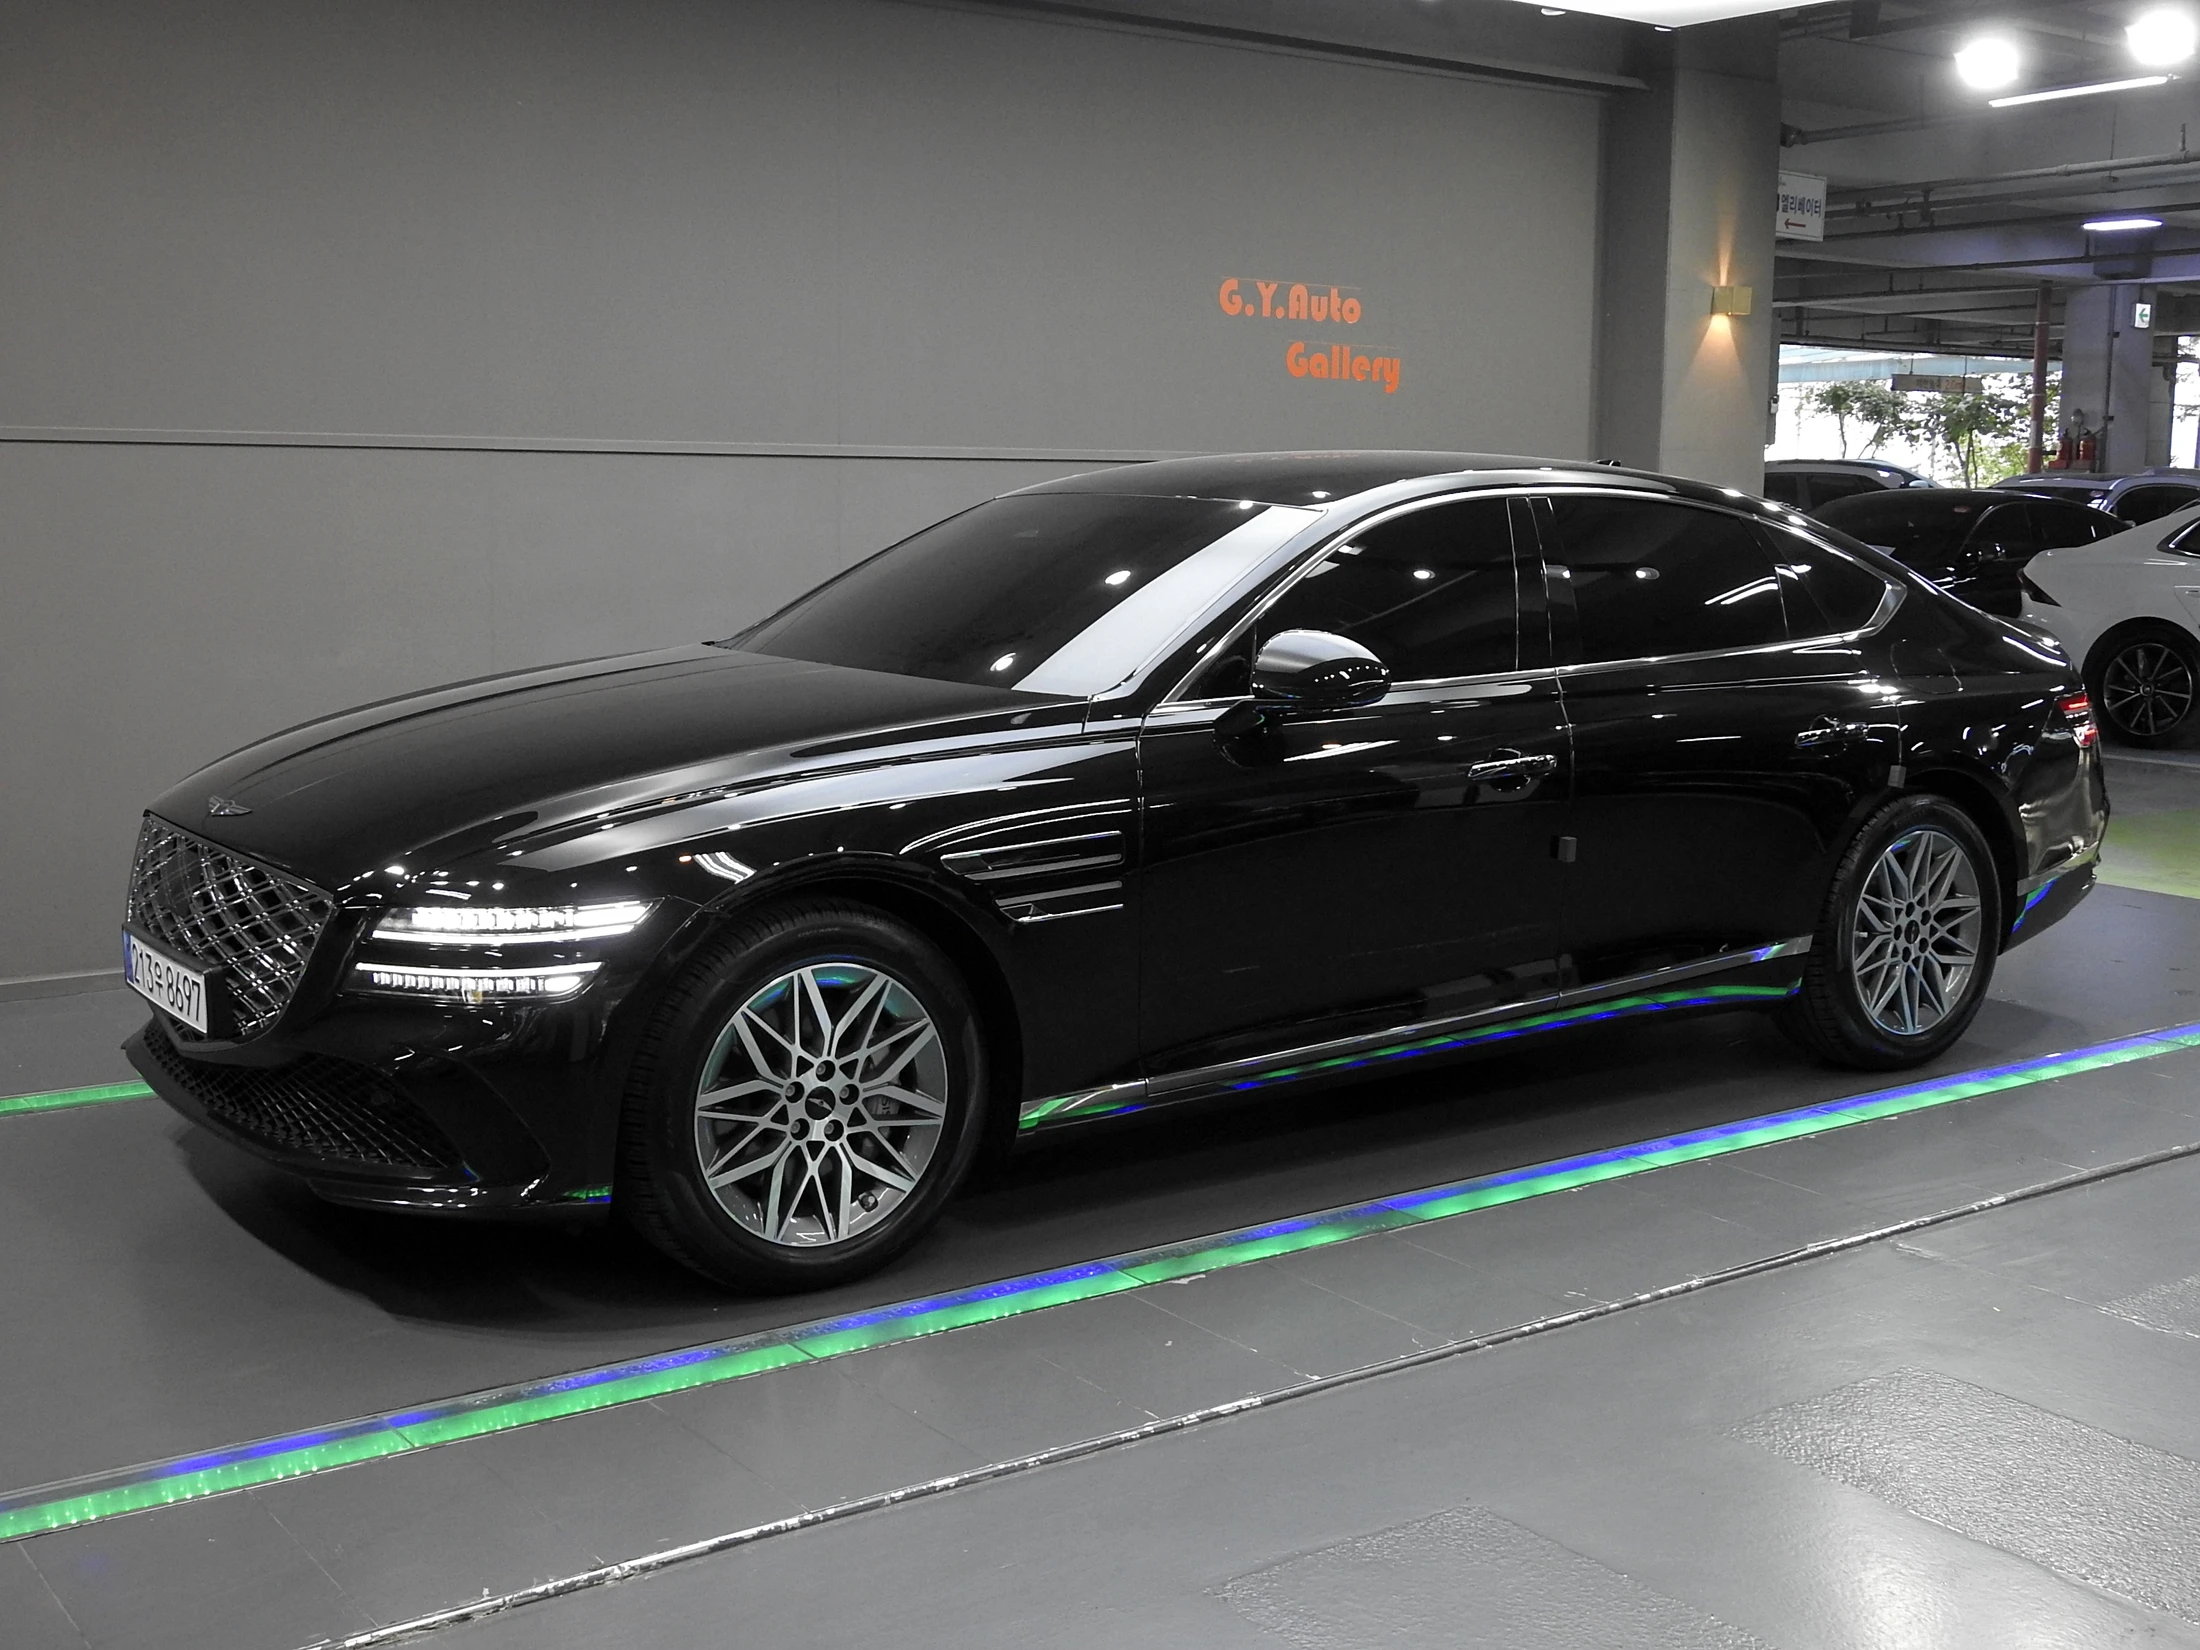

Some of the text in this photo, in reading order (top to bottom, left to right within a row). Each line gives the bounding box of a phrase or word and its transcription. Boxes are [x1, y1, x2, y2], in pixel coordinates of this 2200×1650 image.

[1781, 194, 1821, 218] 엘리베이터
[1219, 278, 1361, 324] G.Y.Auto
[1286, 341, 1400, 394] Gallery
